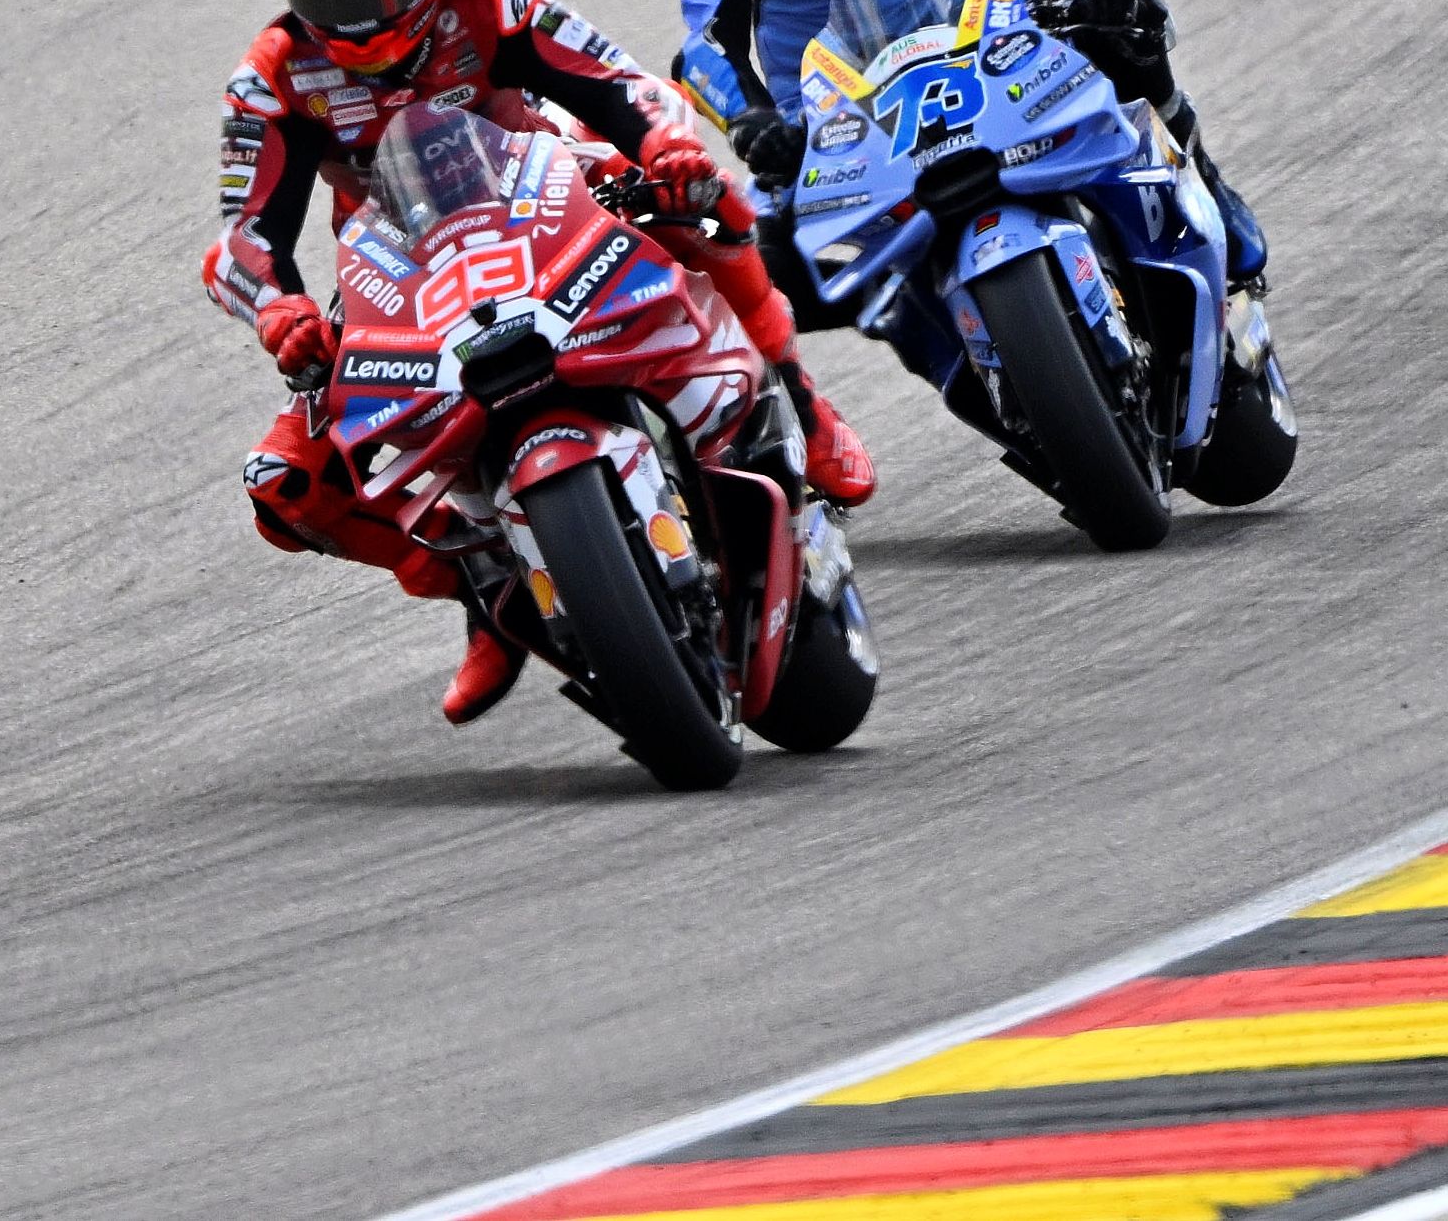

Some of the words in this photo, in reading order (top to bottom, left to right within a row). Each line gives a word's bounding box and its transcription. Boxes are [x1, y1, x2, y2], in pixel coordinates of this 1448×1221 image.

[891, 41, 944, 65] GLOBAL
[434, 86, 472, 108] SHOEI
[872, 51, 988, 165] 73
[538, 159, 577, 217] riello
[357, 240, 410, 278] ADVANCE
[553, 235, 630, 315] Lenovo
[348, 269, 405, 317] riello
[415, 235, 535, 332] 93
[631, 282, 668, 303] TIM
[344, 356, 435, 381] Lenovo
[366, 400, 401, 428] TIM
